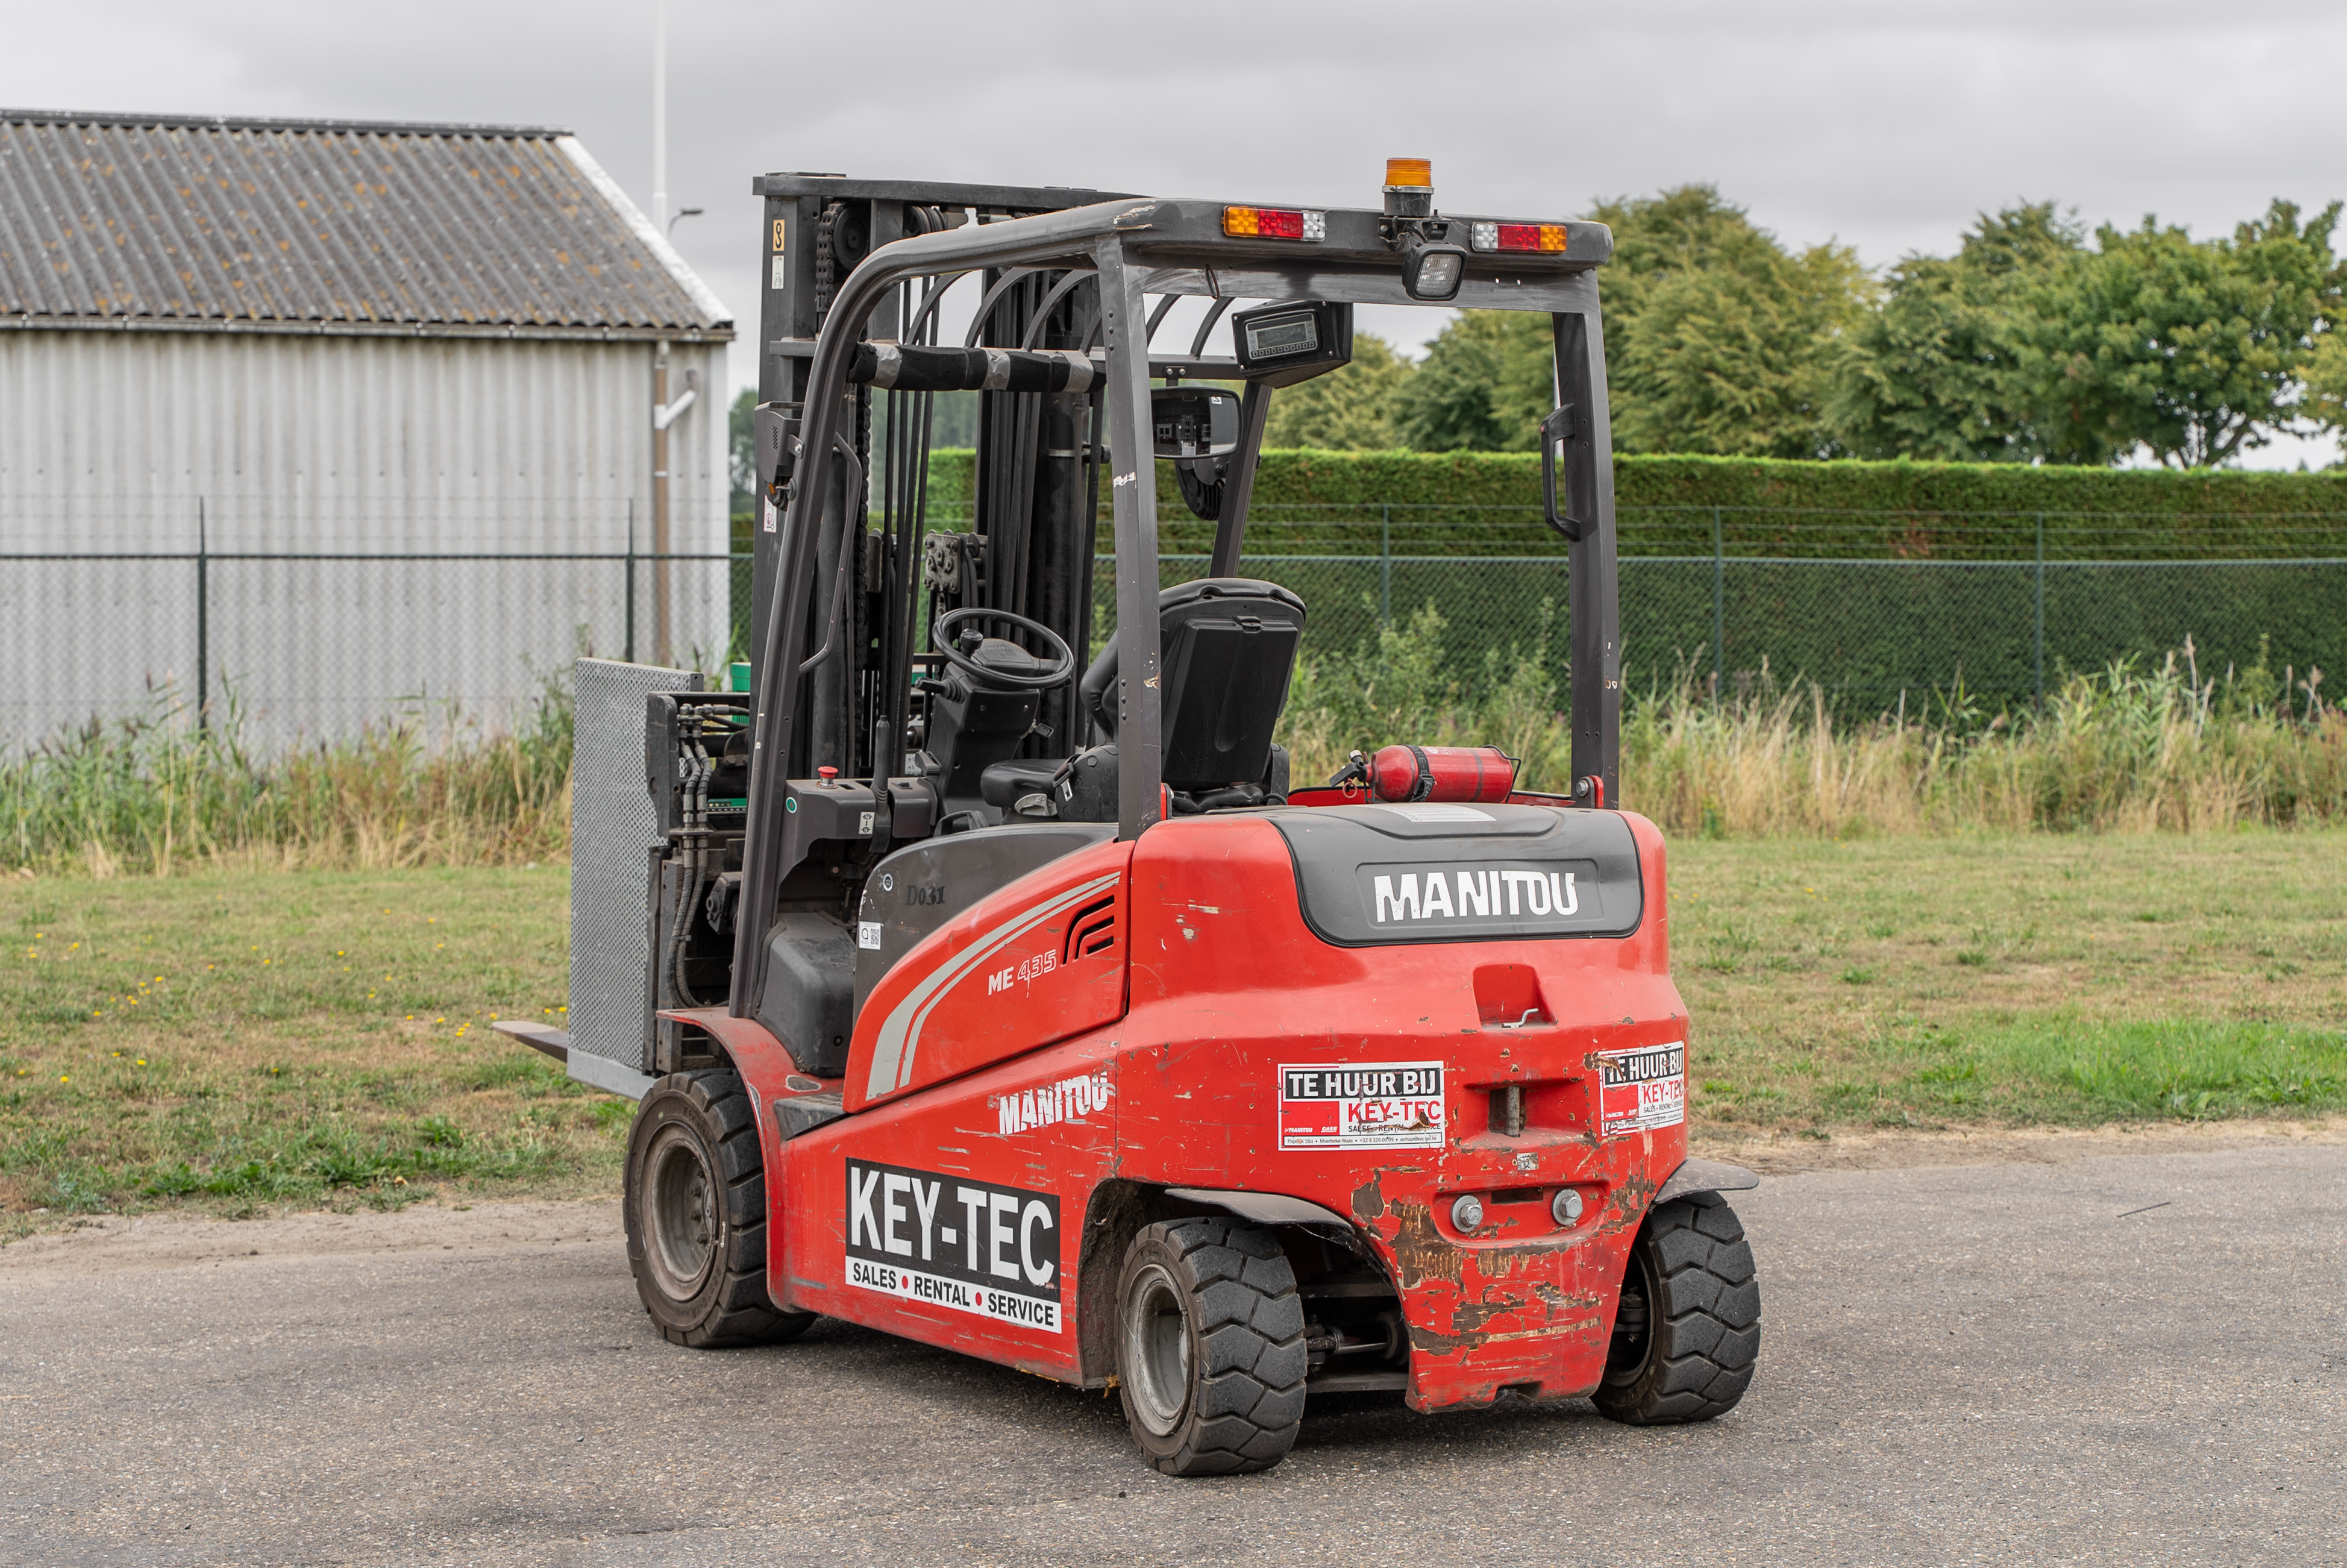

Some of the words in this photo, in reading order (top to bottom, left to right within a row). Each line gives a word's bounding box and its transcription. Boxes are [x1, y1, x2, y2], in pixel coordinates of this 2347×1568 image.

[1374, 871, 1578, 923] MANITOU
[988, 966, 1014, 996] ME
[1017, 949, 1056, 982] 435
[1288, 1073, 1318, 1097] TE
[1326, 1072, 1396, 1096] HUUR
[1403, 1071, 1435, 1095] BIJ
[1629, 1053, 1667, 1080] HUUR
[999, 1071, 1108, 1134] MANITOU
[1348, 1100, 1441, 1122] KEY-TEC
[851, 1167, 1054, 1287] KEY-TEC
[853, 1262, 897, 1290] SALES
[914, 1275, 970, 1307] RENTAL
[988, 1293, 1054, 1327] SERVICE
